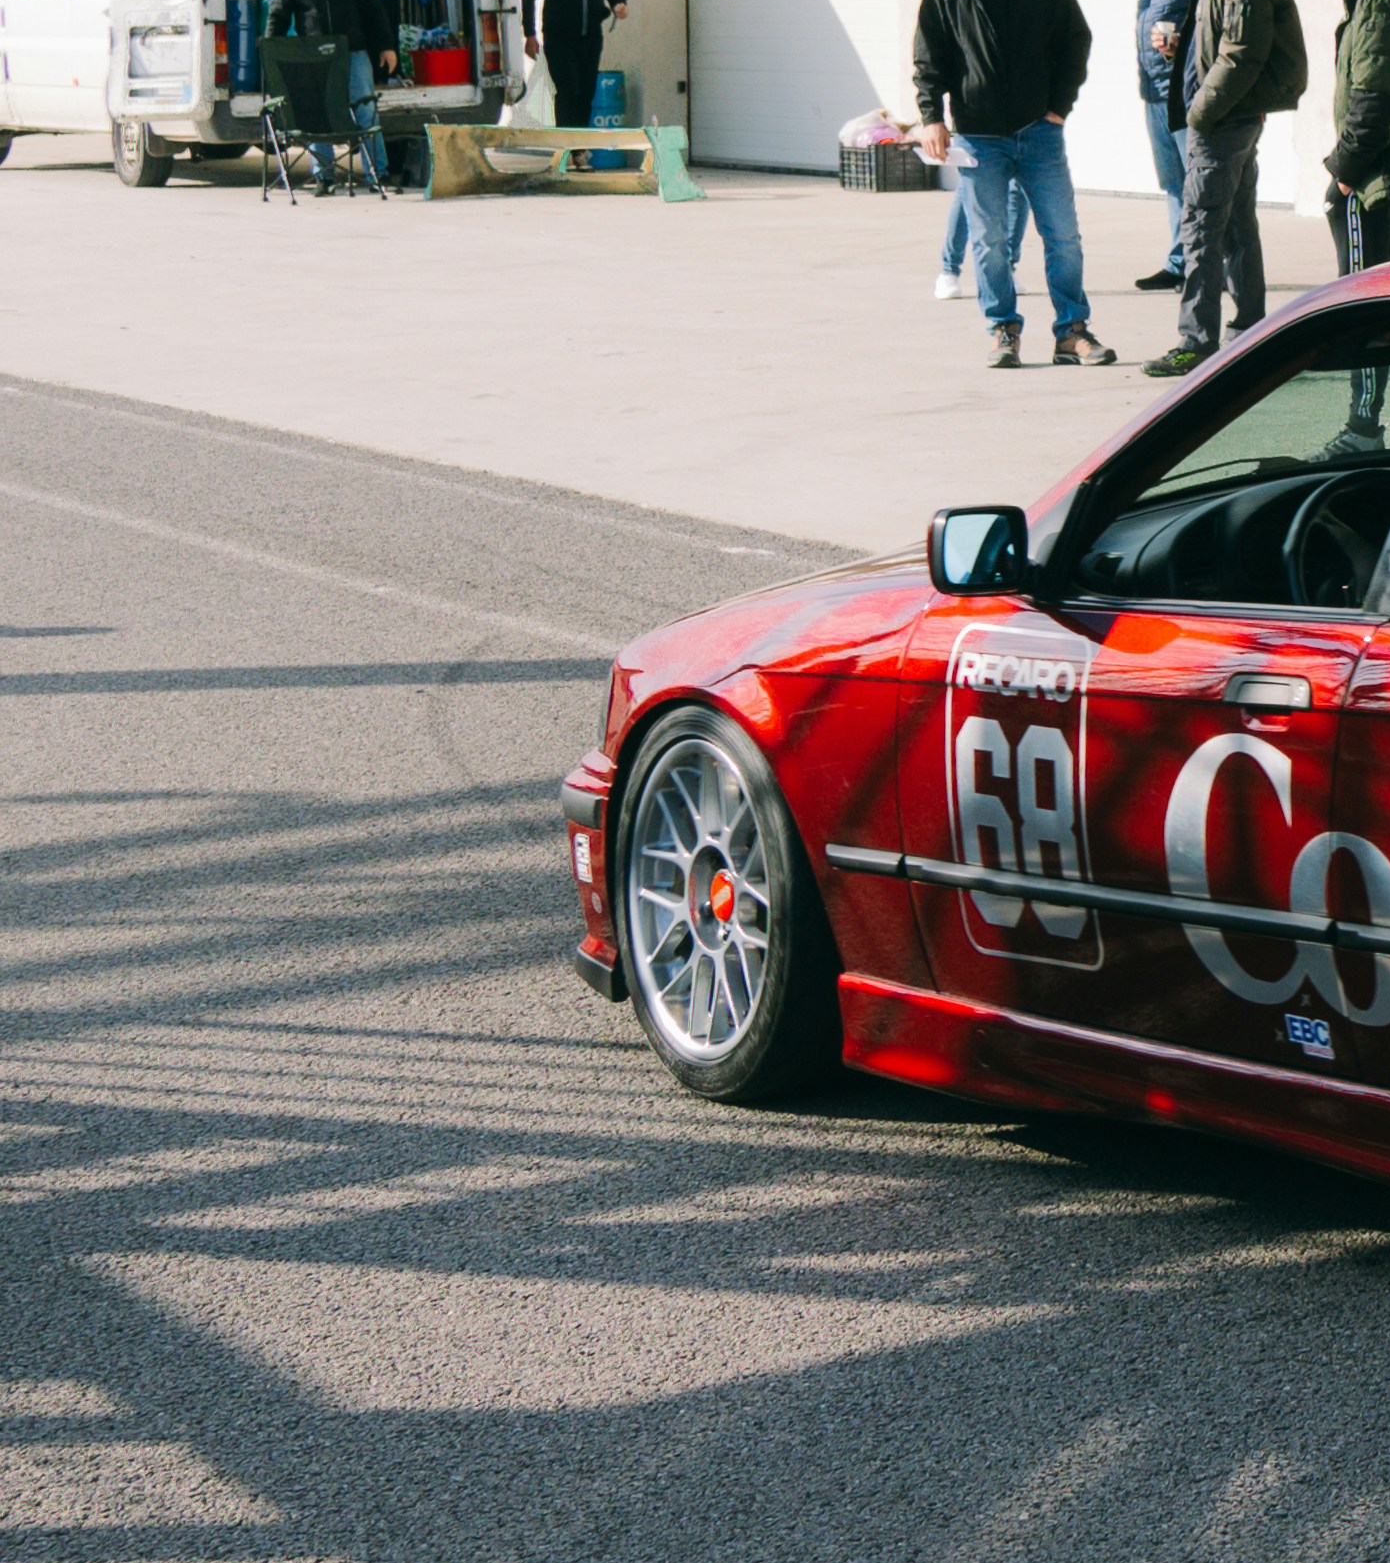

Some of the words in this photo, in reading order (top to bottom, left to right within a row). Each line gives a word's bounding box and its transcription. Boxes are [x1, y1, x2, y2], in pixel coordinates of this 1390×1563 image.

[957, 652, 1076, 703] RECARO
[956, 716, 1088, 940] 68
[1287, 1016, 1330, 1047] EBC
